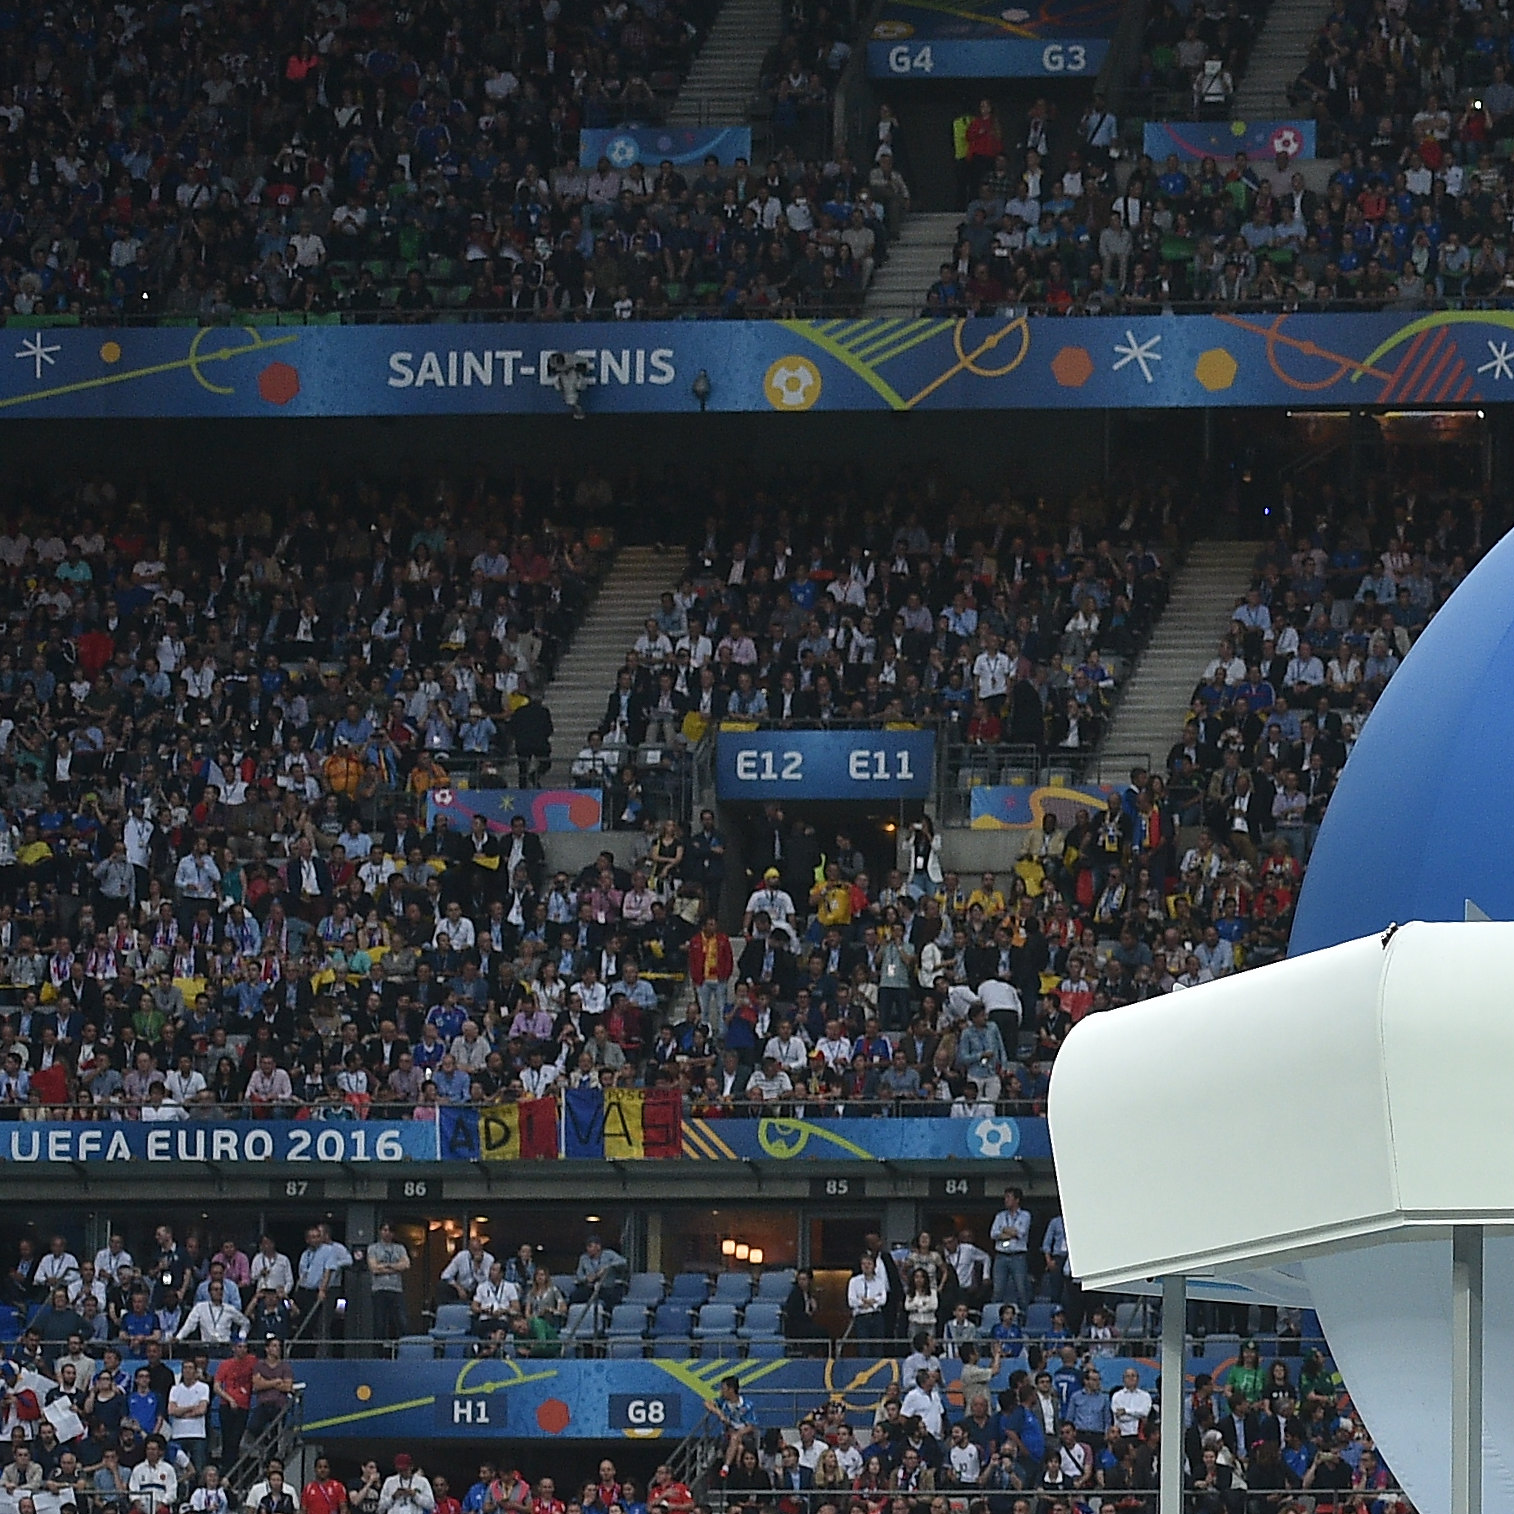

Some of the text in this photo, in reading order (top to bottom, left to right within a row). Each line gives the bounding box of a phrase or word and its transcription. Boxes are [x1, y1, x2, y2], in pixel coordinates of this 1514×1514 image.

[889, 45, 934, 73] G4
[1042, 44, 1086, 72] G3
[735, 750, 803, 780] E12
[849, 749, 914, 780] E11
[11, 1129, 403, 1160] UEFA EURO 2016
[286, 1181, 308, 1197] 87
[404, 1182, 427, 1197] 86
[826, 1179, 849, 1195] 85
[945, 1179, 968, 1195] 84
[453, 1400, 490, 1423] H1
[628, 1400, 665, 1424] G8
